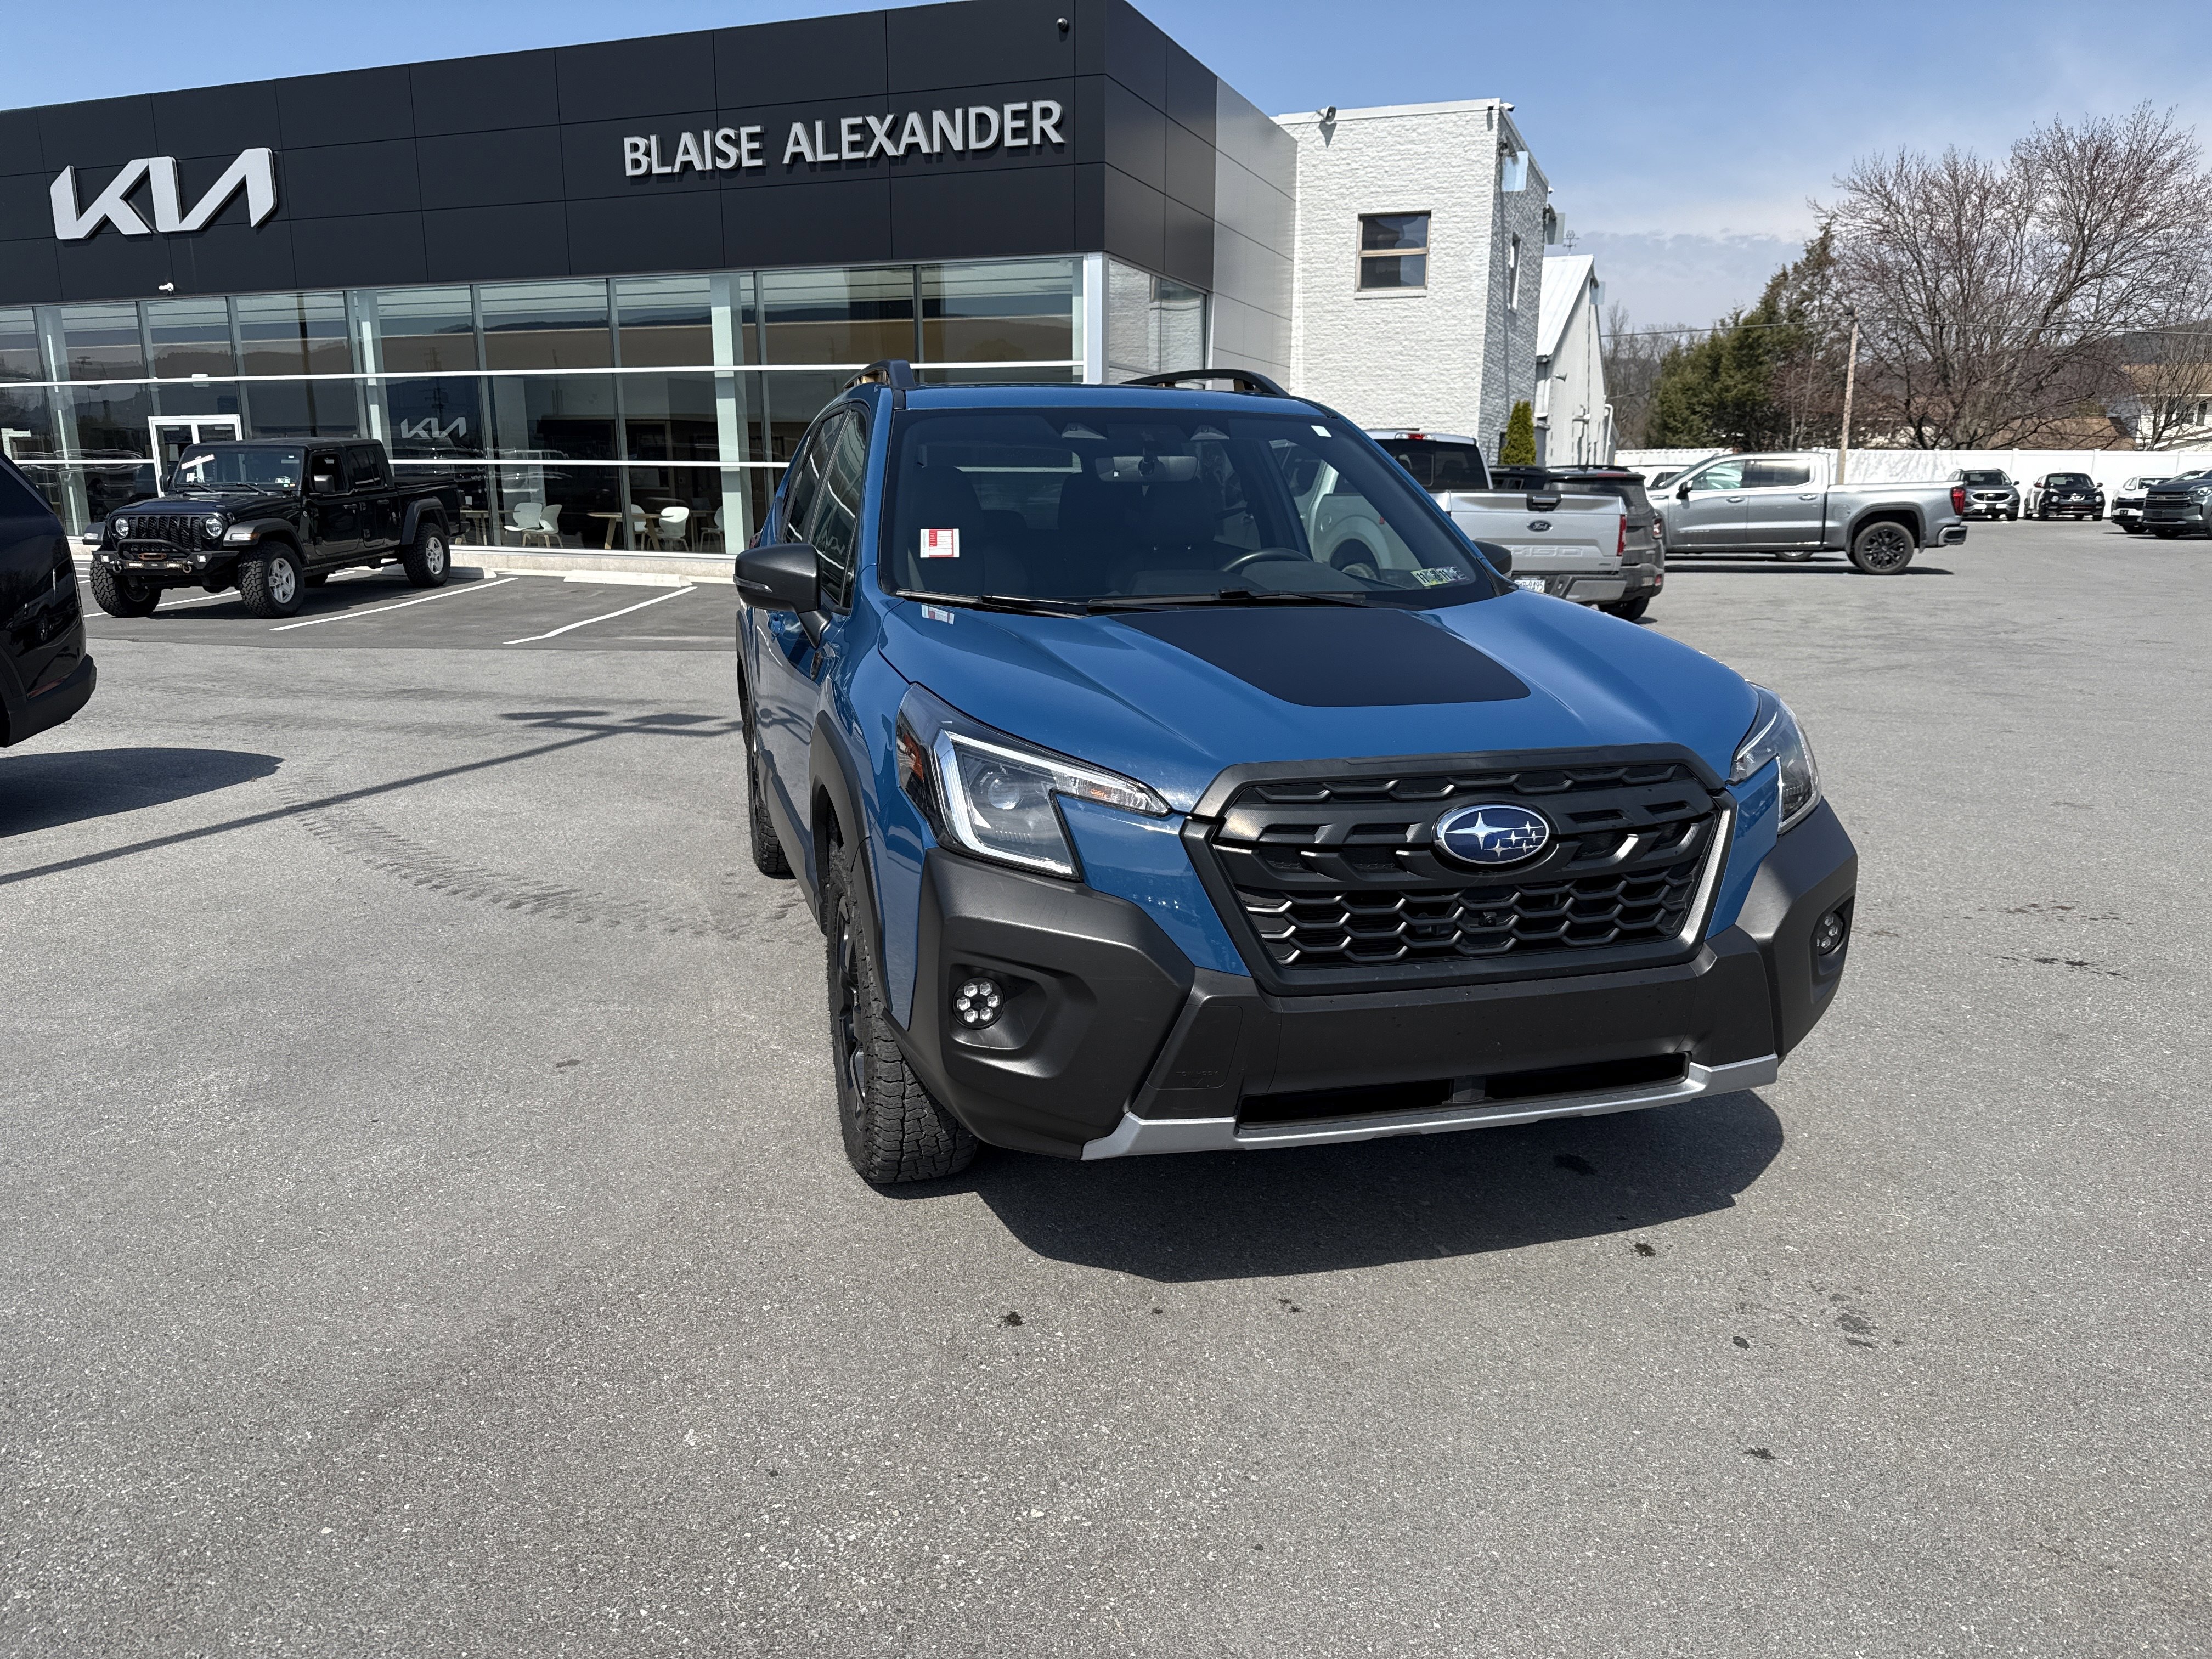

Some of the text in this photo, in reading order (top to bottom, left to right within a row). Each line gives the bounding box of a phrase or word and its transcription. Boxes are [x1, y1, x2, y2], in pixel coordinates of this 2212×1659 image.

[623, 99, 1064, 177] BLAISE ALEXANDER
[50, 147, 278, 240] KIA
[400, 417, 467, 438] KIA
